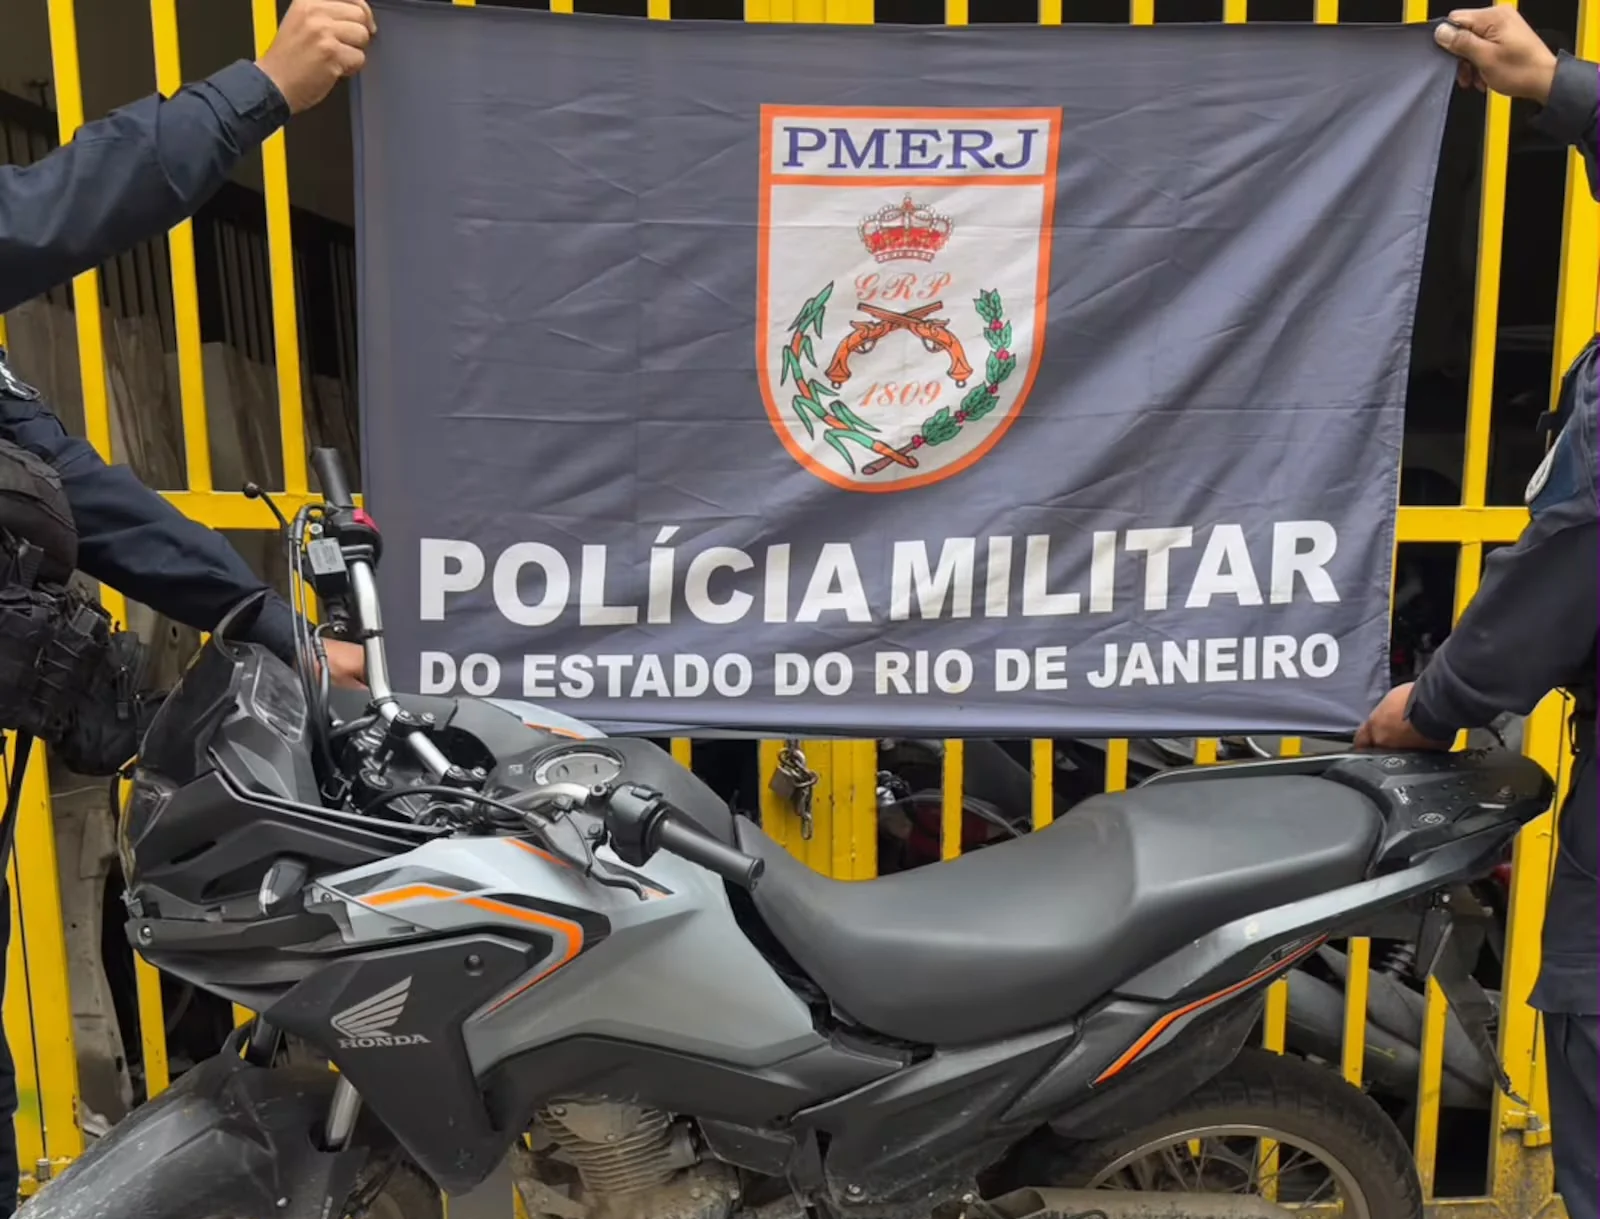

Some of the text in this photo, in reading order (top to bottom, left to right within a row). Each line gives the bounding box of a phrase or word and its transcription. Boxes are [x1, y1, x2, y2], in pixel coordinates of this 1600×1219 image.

[781, 126, 1039, 169] PMERJ
[857, 381, 942, 407] 1809
[419, 519, 1341, 627] POLÍCIA MILITAR
[419, 632, 1341, 698] DO ESTADO DO RIO DE JANEIRO
[337, 1033, 432, 1049] HONDA
